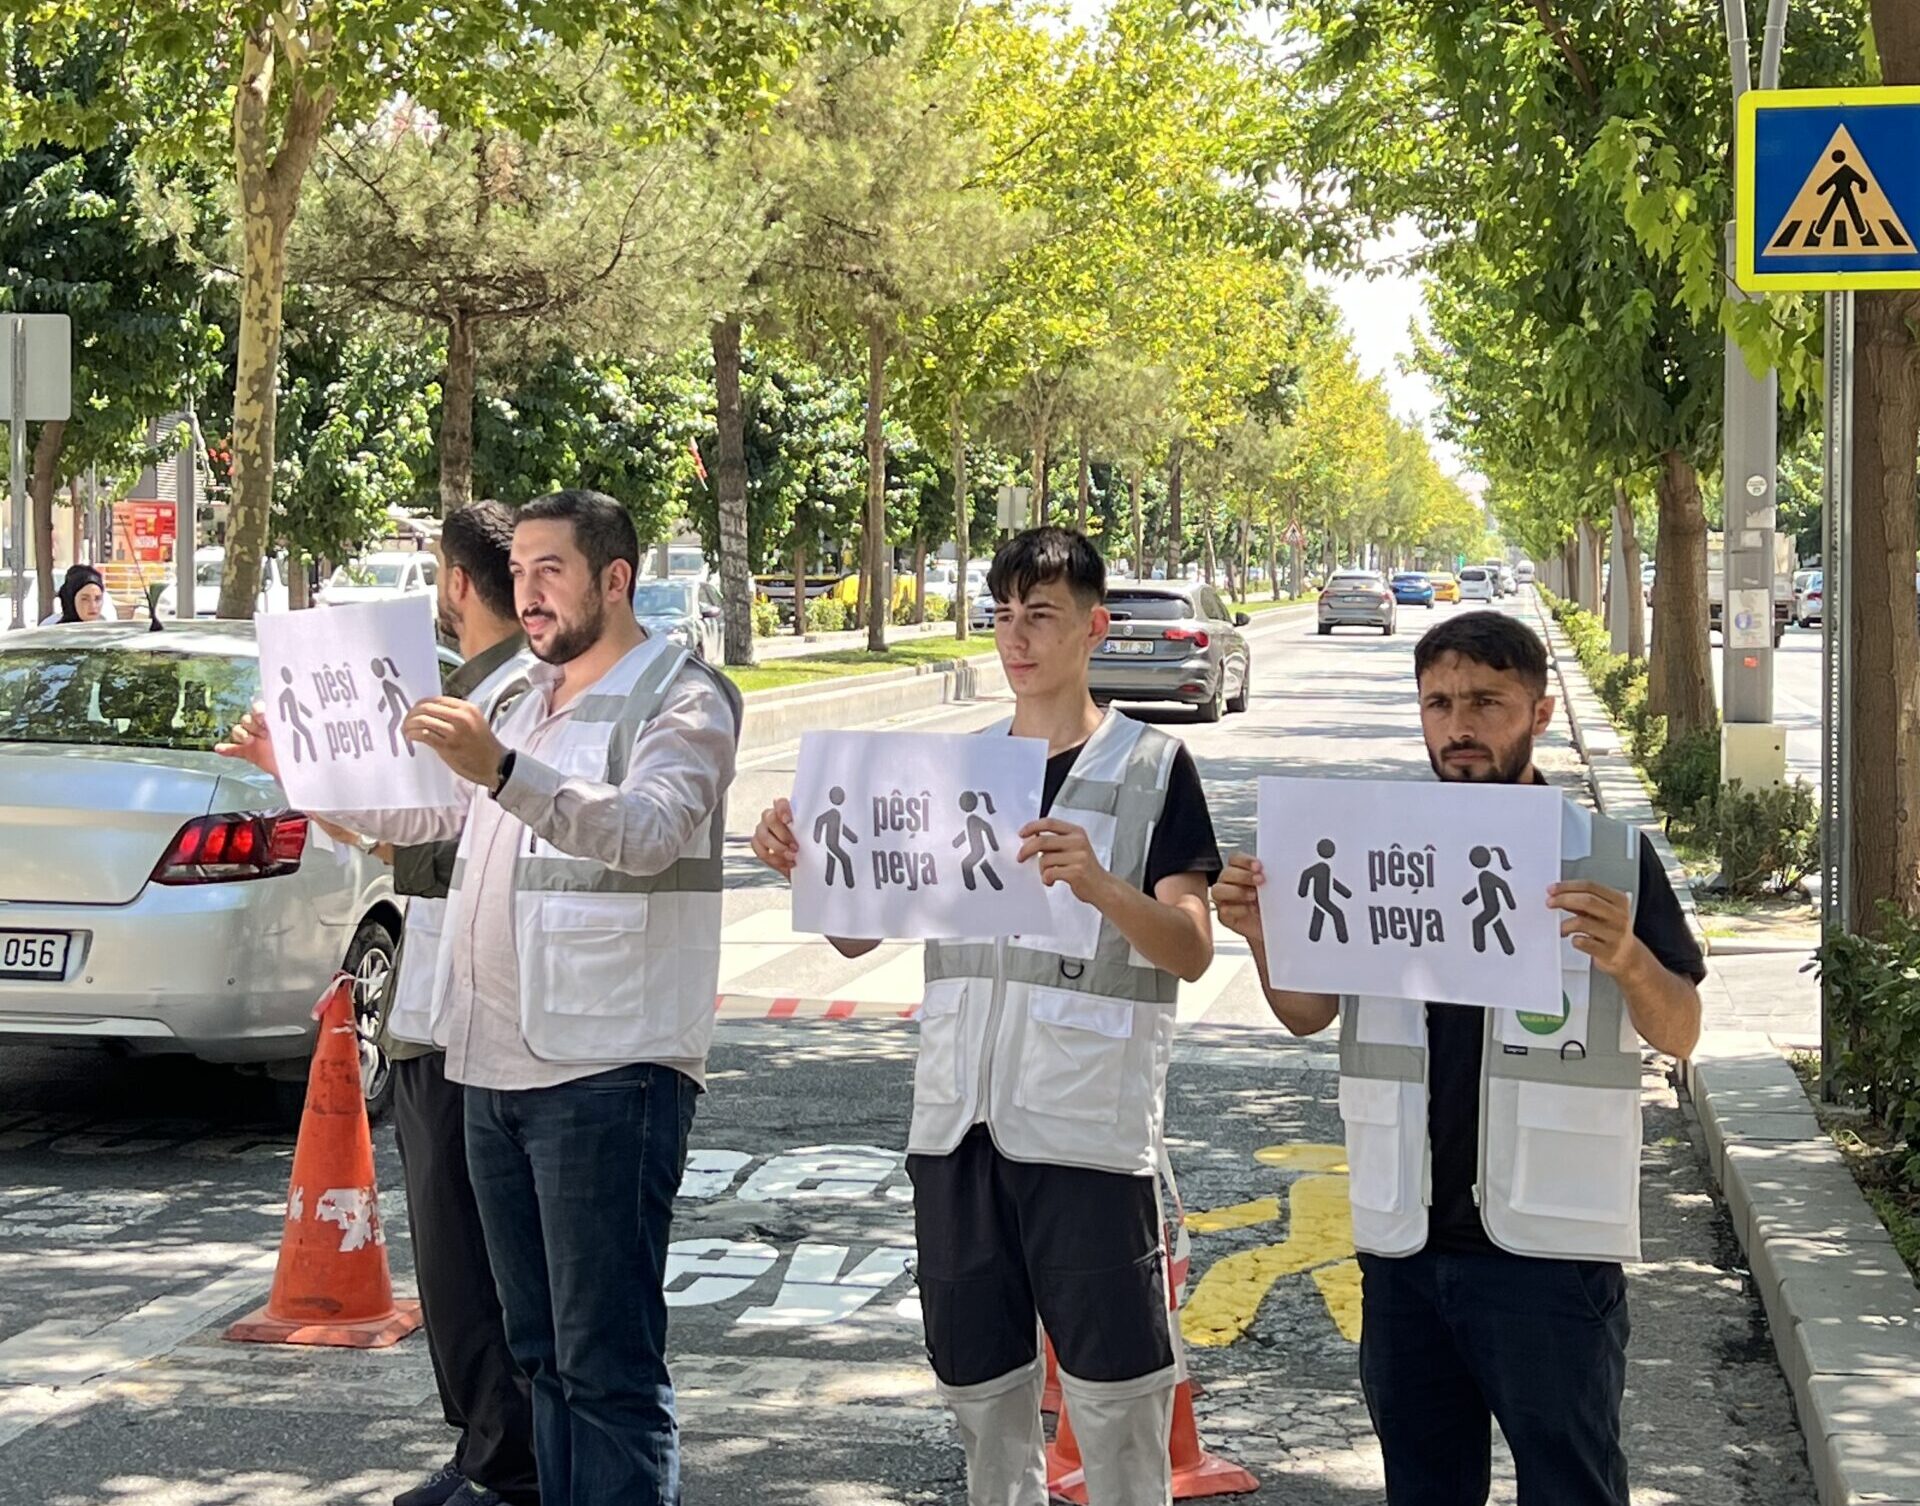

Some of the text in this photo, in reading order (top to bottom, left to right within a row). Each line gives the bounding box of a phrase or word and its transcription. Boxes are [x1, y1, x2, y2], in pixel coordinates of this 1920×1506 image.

[311, 661, 359, 710] pêşî
[324, 718, 374, 761] peya
[872, 788, 932, 839] pêşî
[872, 849, 938, 891] peya
[1368, 842, 1437, 894] pêşî
[1368, 905, 1445, 947] peya
[4, 938, 55, 967] 056
